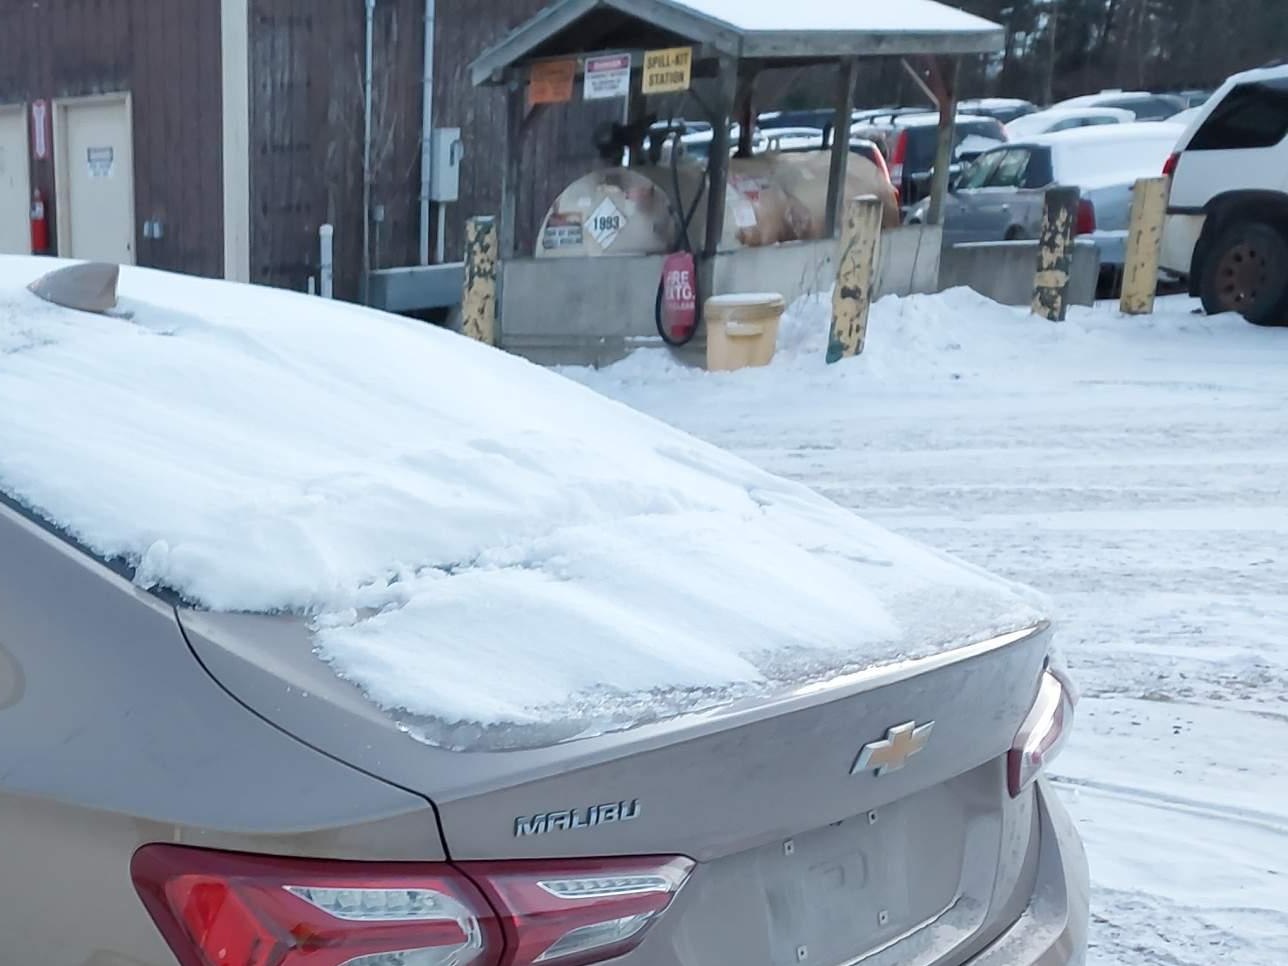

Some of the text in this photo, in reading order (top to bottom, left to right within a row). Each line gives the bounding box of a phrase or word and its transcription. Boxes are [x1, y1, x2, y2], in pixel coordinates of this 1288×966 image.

[648, 72, 685, 87] STATION
[593, 216, 620, 231] 1993
[513, 799, 642, 838] MALIBU
